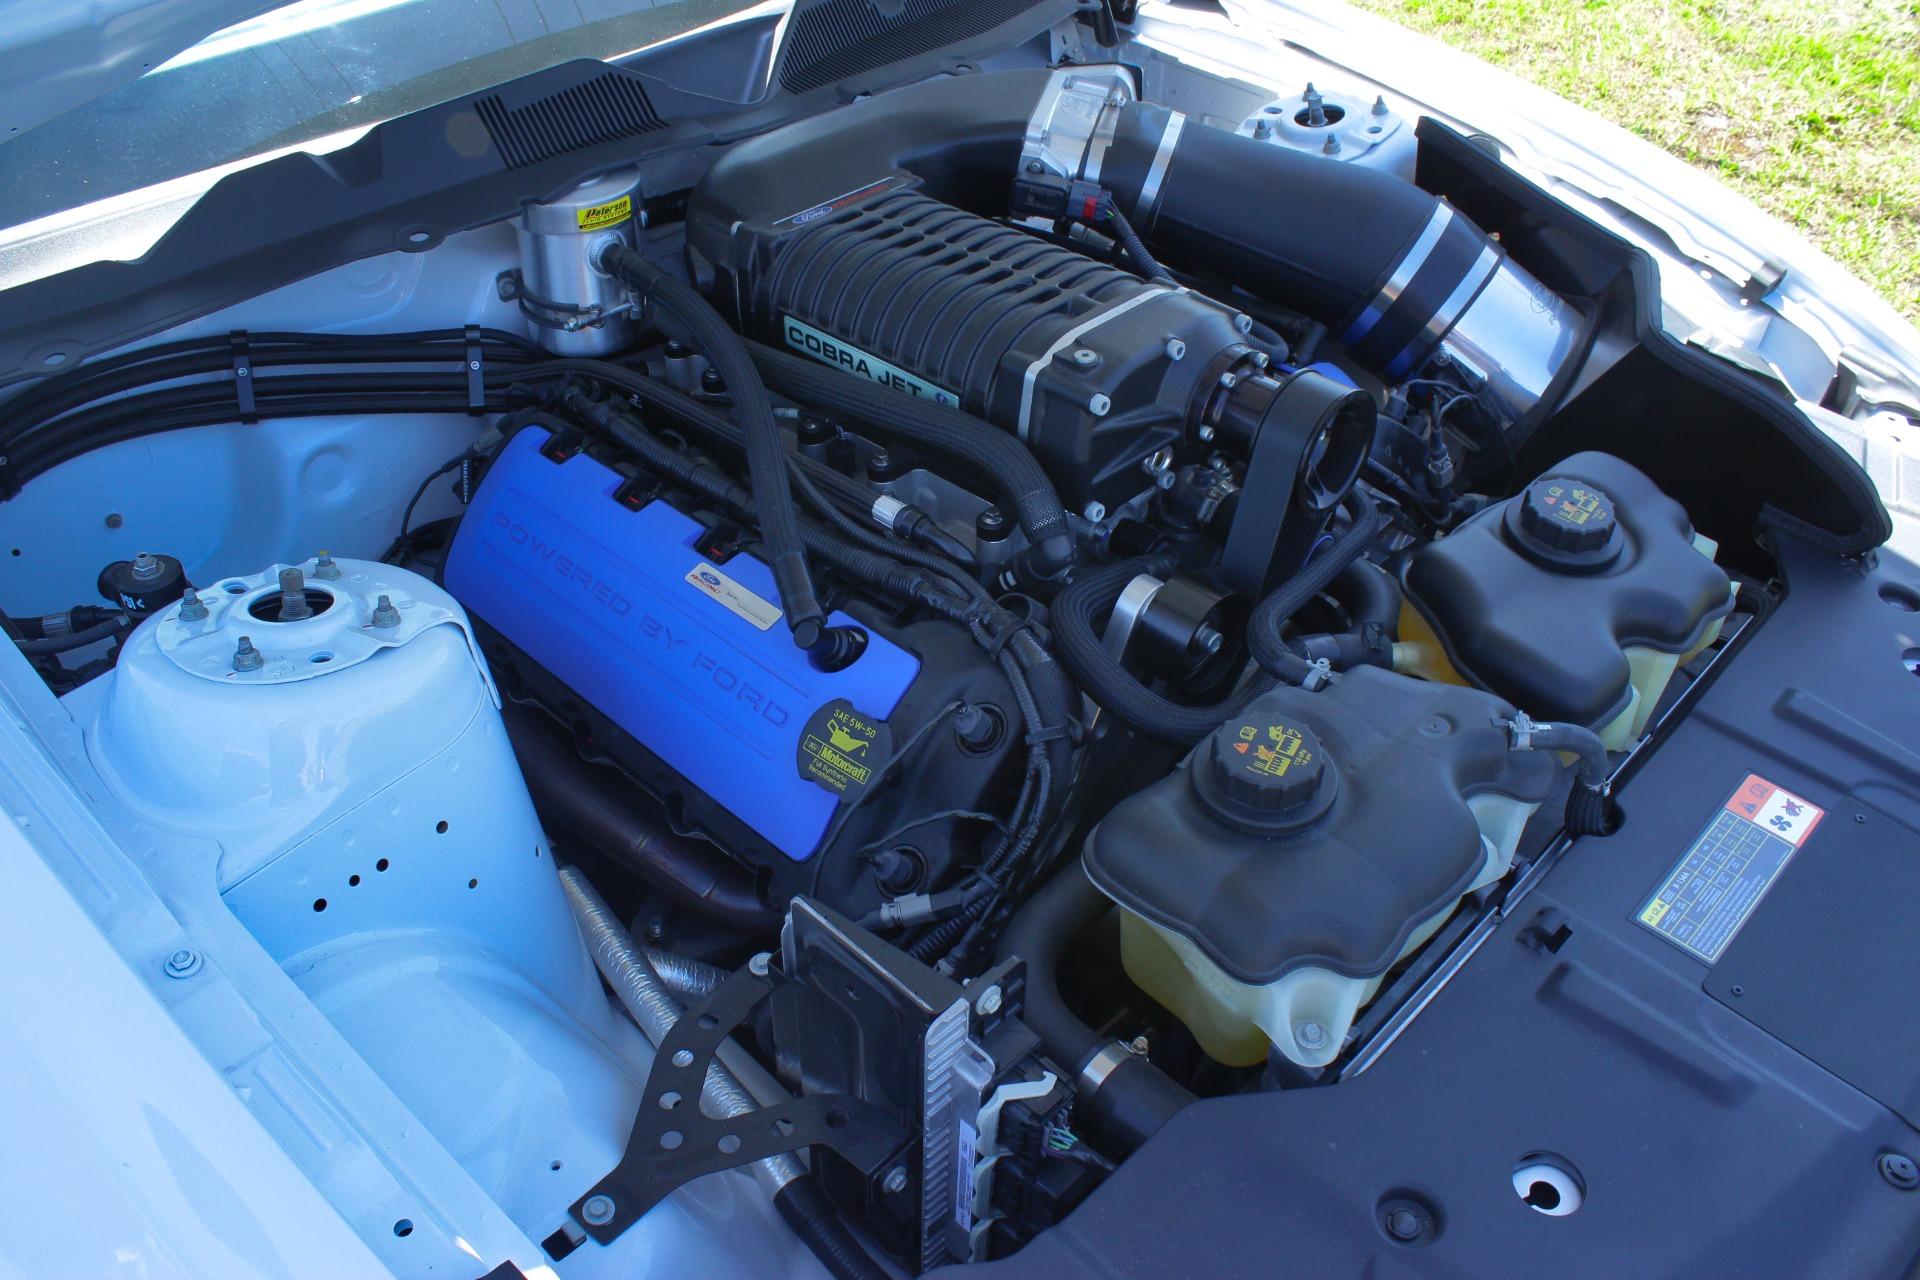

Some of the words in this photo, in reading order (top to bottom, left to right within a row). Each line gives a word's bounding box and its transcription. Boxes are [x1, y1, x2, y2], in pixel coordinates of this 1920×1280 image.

[583, 199, 628, 219] Peterson
[789, 325, 872, 379] COBRA
[877, 371, 922, 396] JET
[491, 511, 632, 616] POWERED
[639, 613, 688, 650] BY
[692, 650, 791, 728] FORD
[833, 709, 850, 723] SAE
[849, 718, 876, 738] 5W-50
[820, 746, 867, 781] Motorcraft
